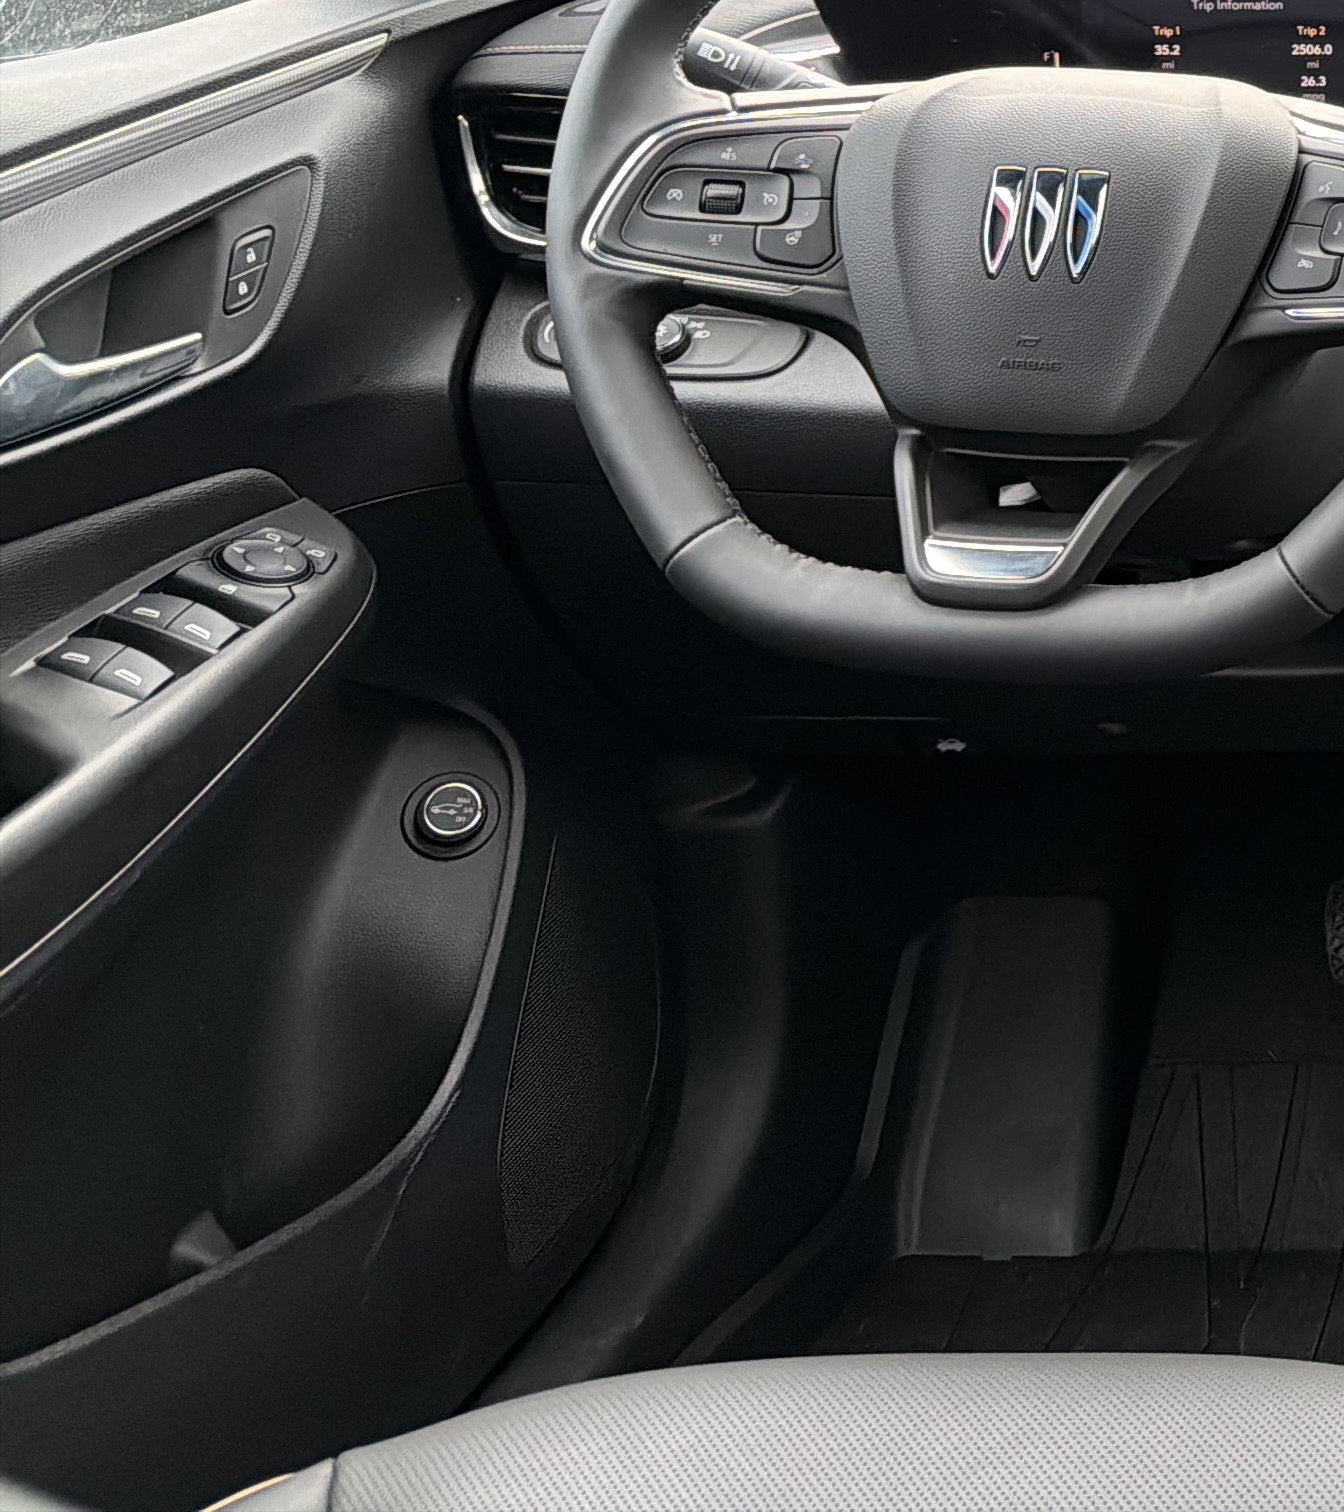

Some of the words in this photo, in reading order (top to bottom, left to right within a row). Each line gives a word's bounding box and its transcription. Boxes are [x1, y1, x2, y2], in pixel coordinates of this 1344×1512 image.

[1191, 0, 1215, 13] Trip
[1217, 0, 1284, 11] Information
[1152, 26, 1174, 37] Trip
[1297, 26, 1318, 37] Trip
[1319, 26, 1327, 35] 2
[1153, 44, 1181, 56] 35.2
[1291, 44, 1333, 56] 2506.0
[1161, 61, 1175, 69] mi
[1306, 60, 1320, 69] mi
[1300, 76, 1327, 88] 26.3
[721, 152, 737, 161] RES
[708, 233, 723, 242] SET
[1000, 358, 1062, 372] AIRBAG
